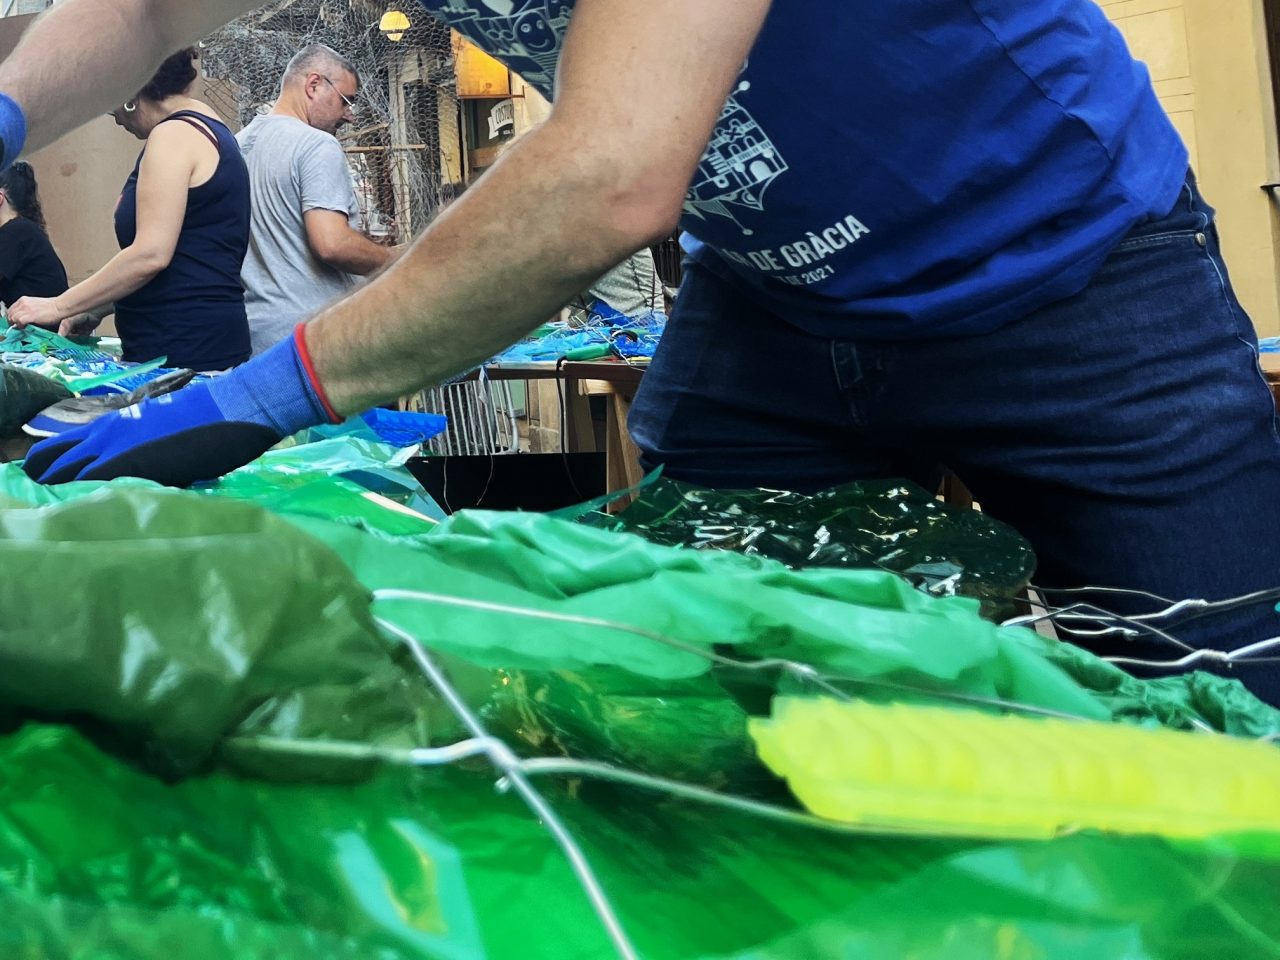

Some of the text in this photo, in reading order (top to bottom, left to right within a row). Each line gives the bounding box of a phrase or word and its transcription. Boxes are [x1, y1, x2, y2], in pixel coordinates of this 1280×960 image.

[747, 249, 785, 271] DE
[779, 214, 871, 268] GRÀCIA
[801, 264, 836, 284] 2021
